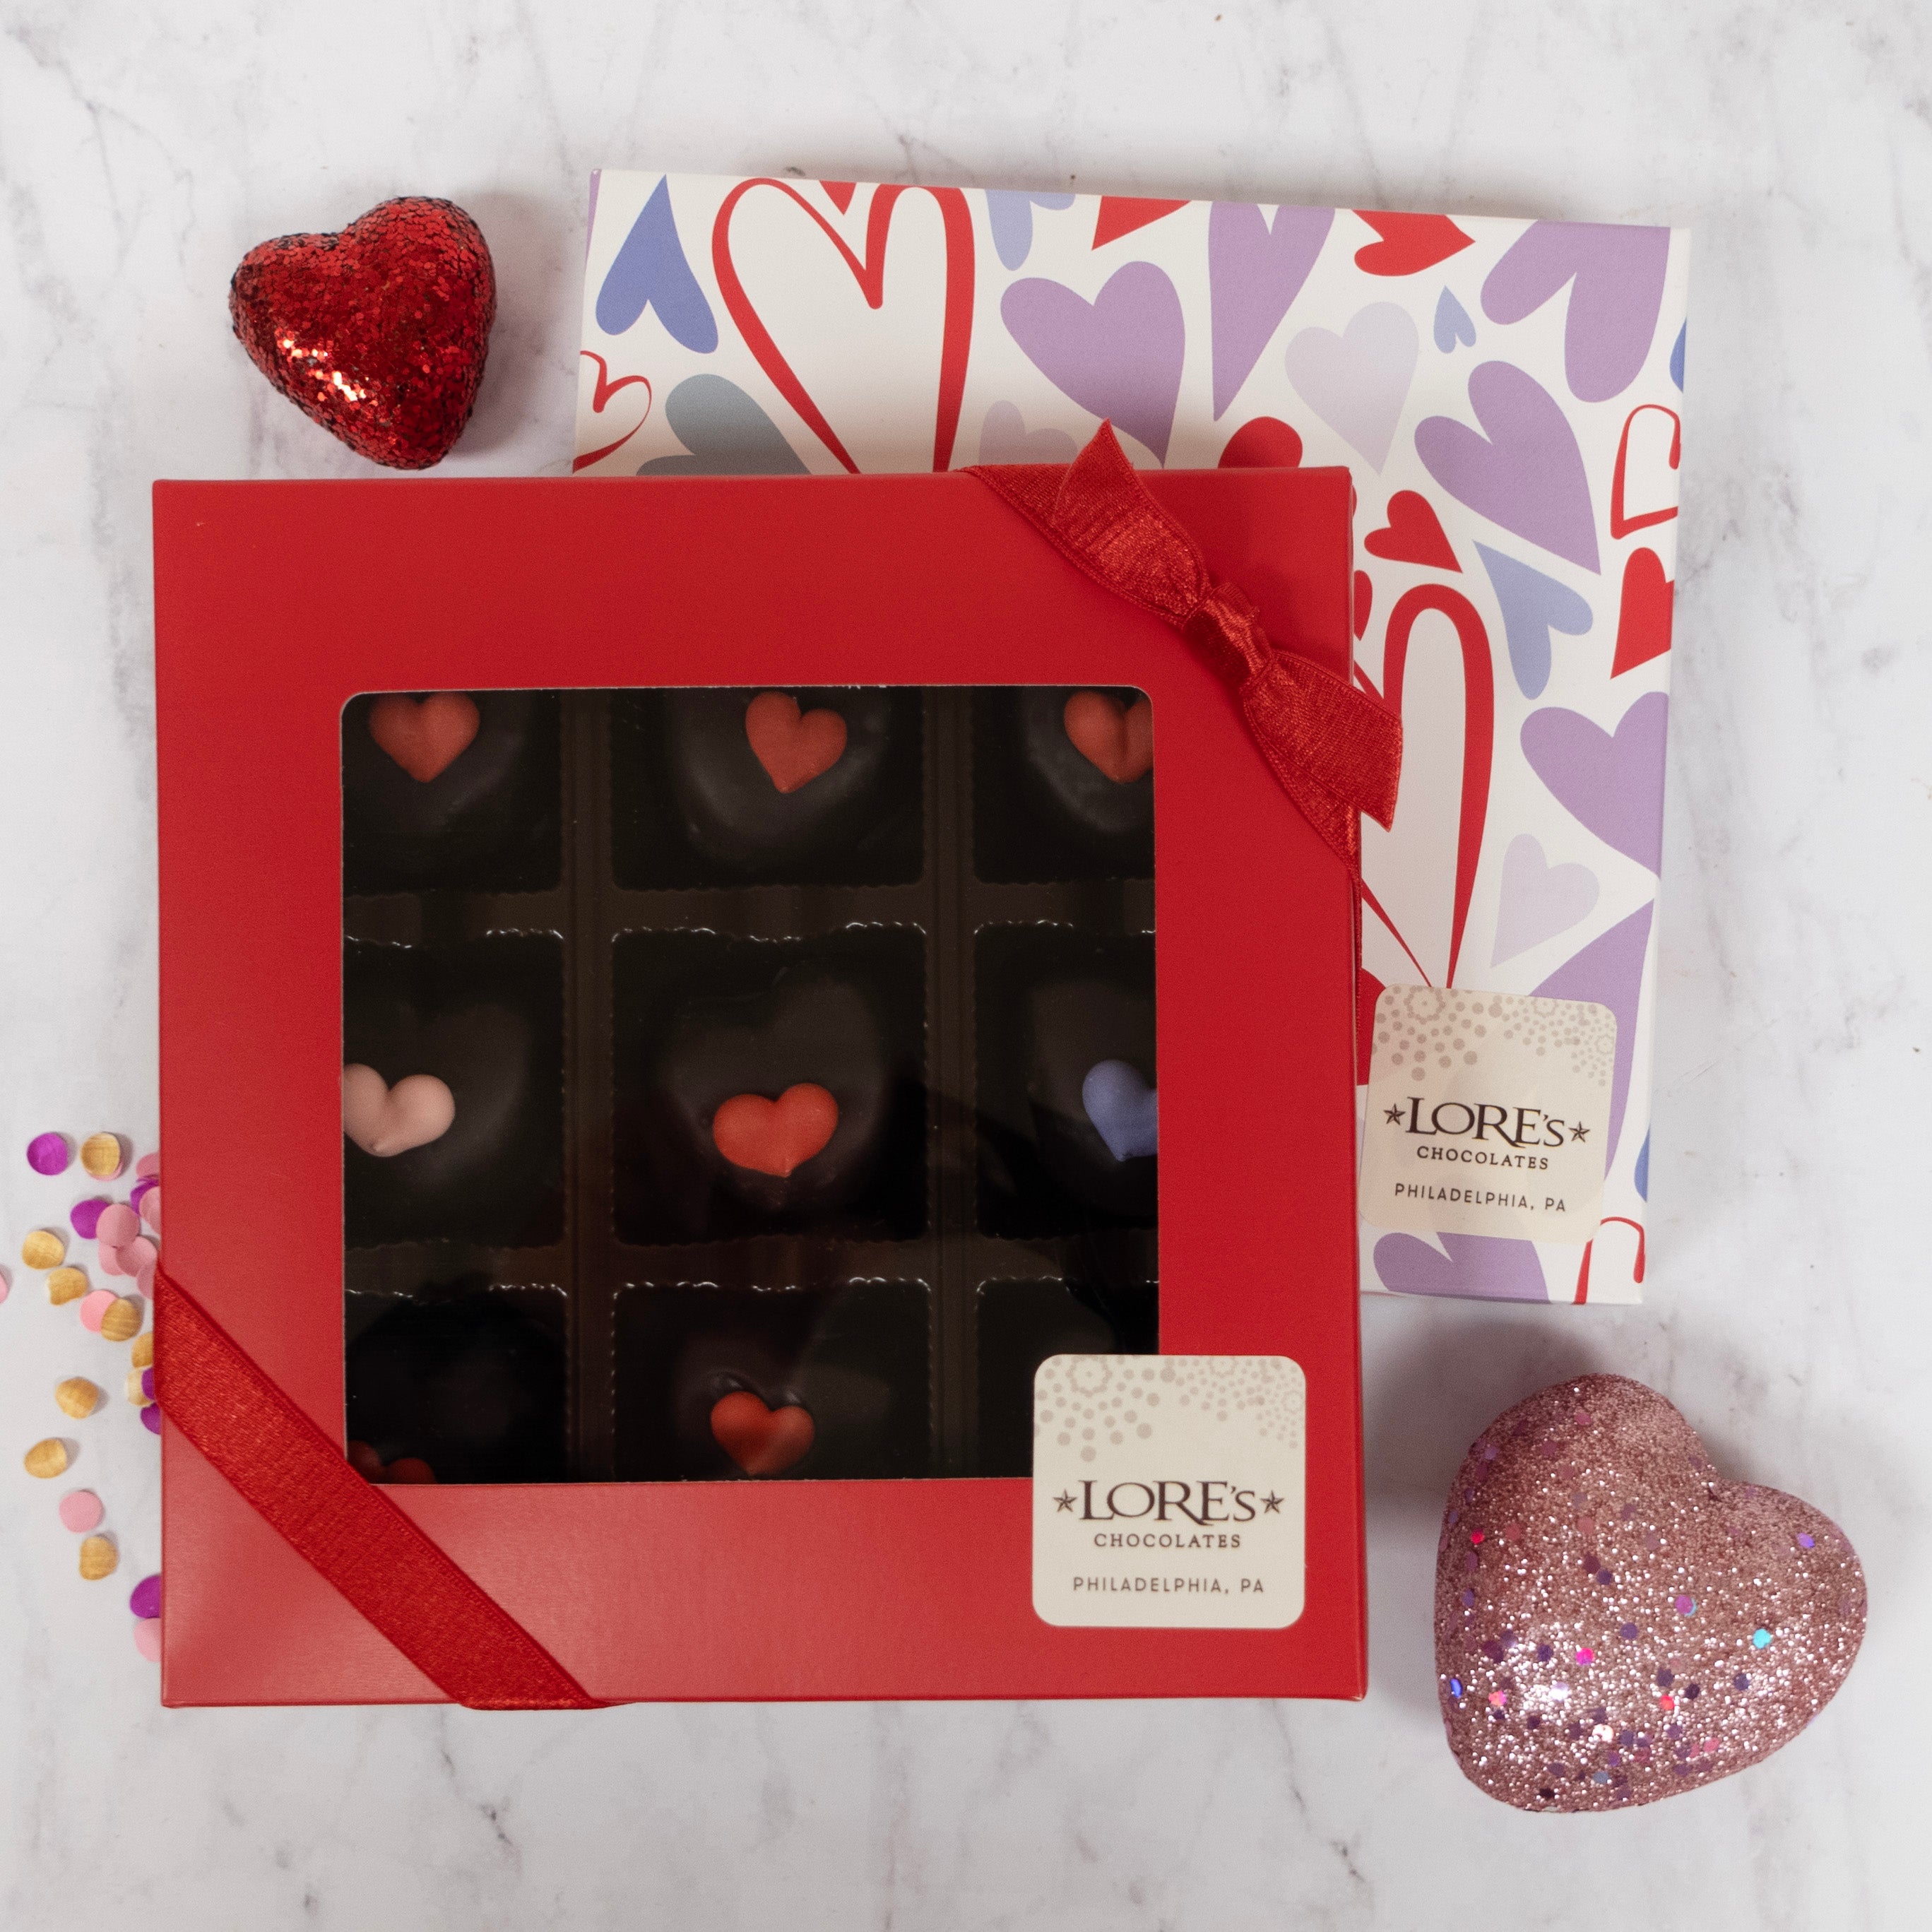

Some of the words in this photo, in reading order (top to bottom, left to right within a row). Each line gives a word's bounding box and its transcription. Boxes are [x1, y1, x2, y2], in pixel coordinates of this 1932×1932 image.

[1416, 1145, 1549, 1170] CHOCOLATES
[1394, 1183, 1535, 1211] PHILADELPHIA,
[1544, 1197, 1566, 1212] PA
[1094, 1533, 1241, 1548] CHOCOLATES
[1073, 1576, 1229, 1594] PHILADELPHIA,
[1240, 1578, 1264, 1593] PA
